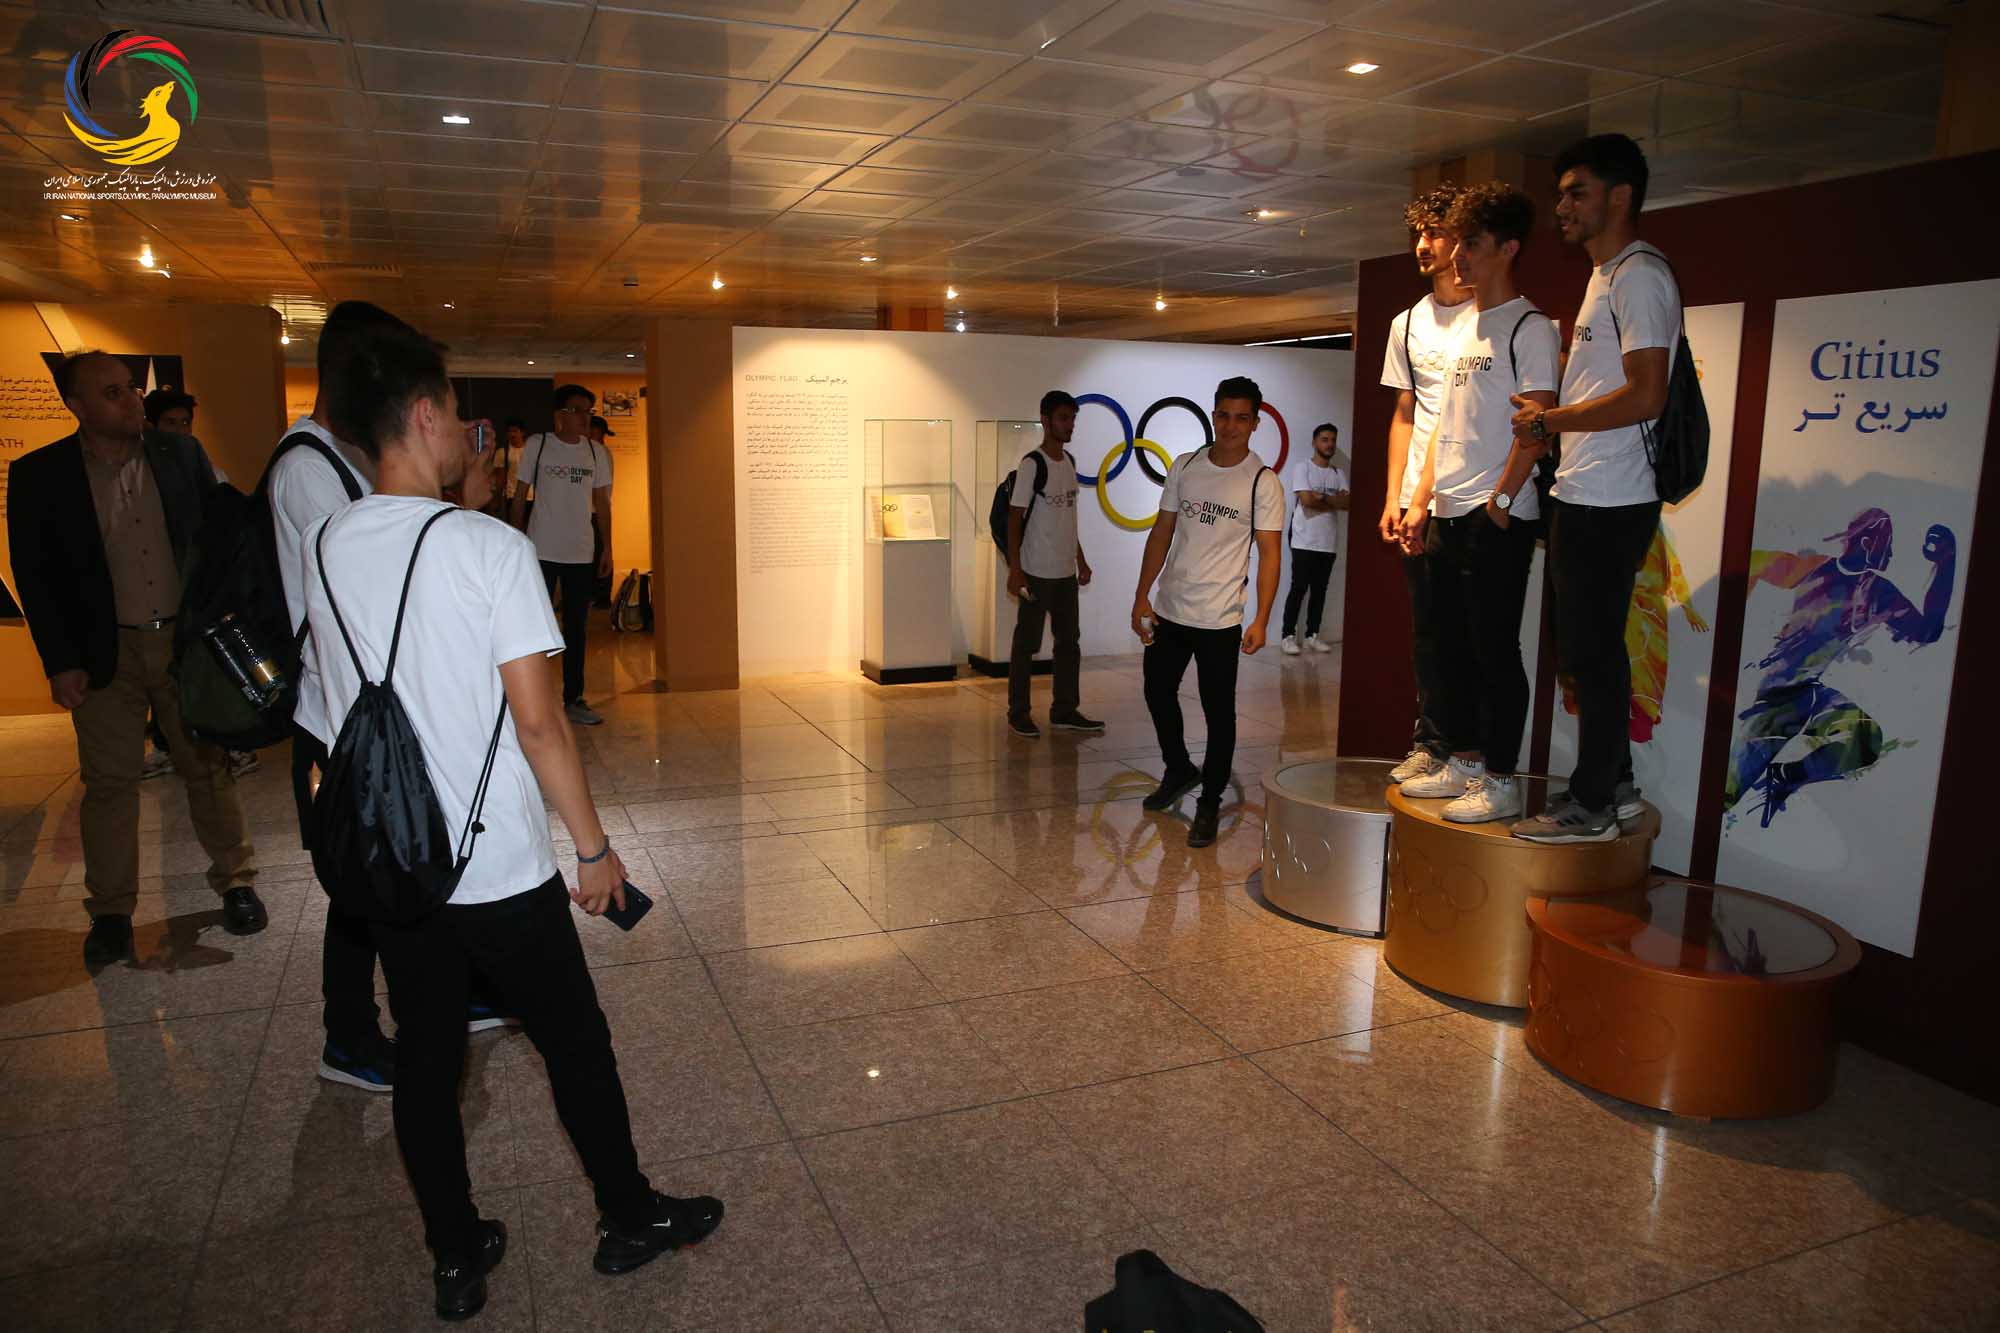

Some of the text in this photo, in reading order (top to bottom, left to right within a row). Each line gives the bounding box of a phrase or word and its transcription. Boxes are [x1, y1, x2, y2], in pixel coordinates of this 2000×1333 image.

[1456, 356, 1492, 372] OLYMPIC
[1810, 339, 1941, 381] Citius
[1455, 373, 1468, 387] DAY
[1792, 393, 1948, 433] سریع تر
[1202, 501, 1239, 519] OLYMPIC
[1200, 512, 1217, 526] DAY
